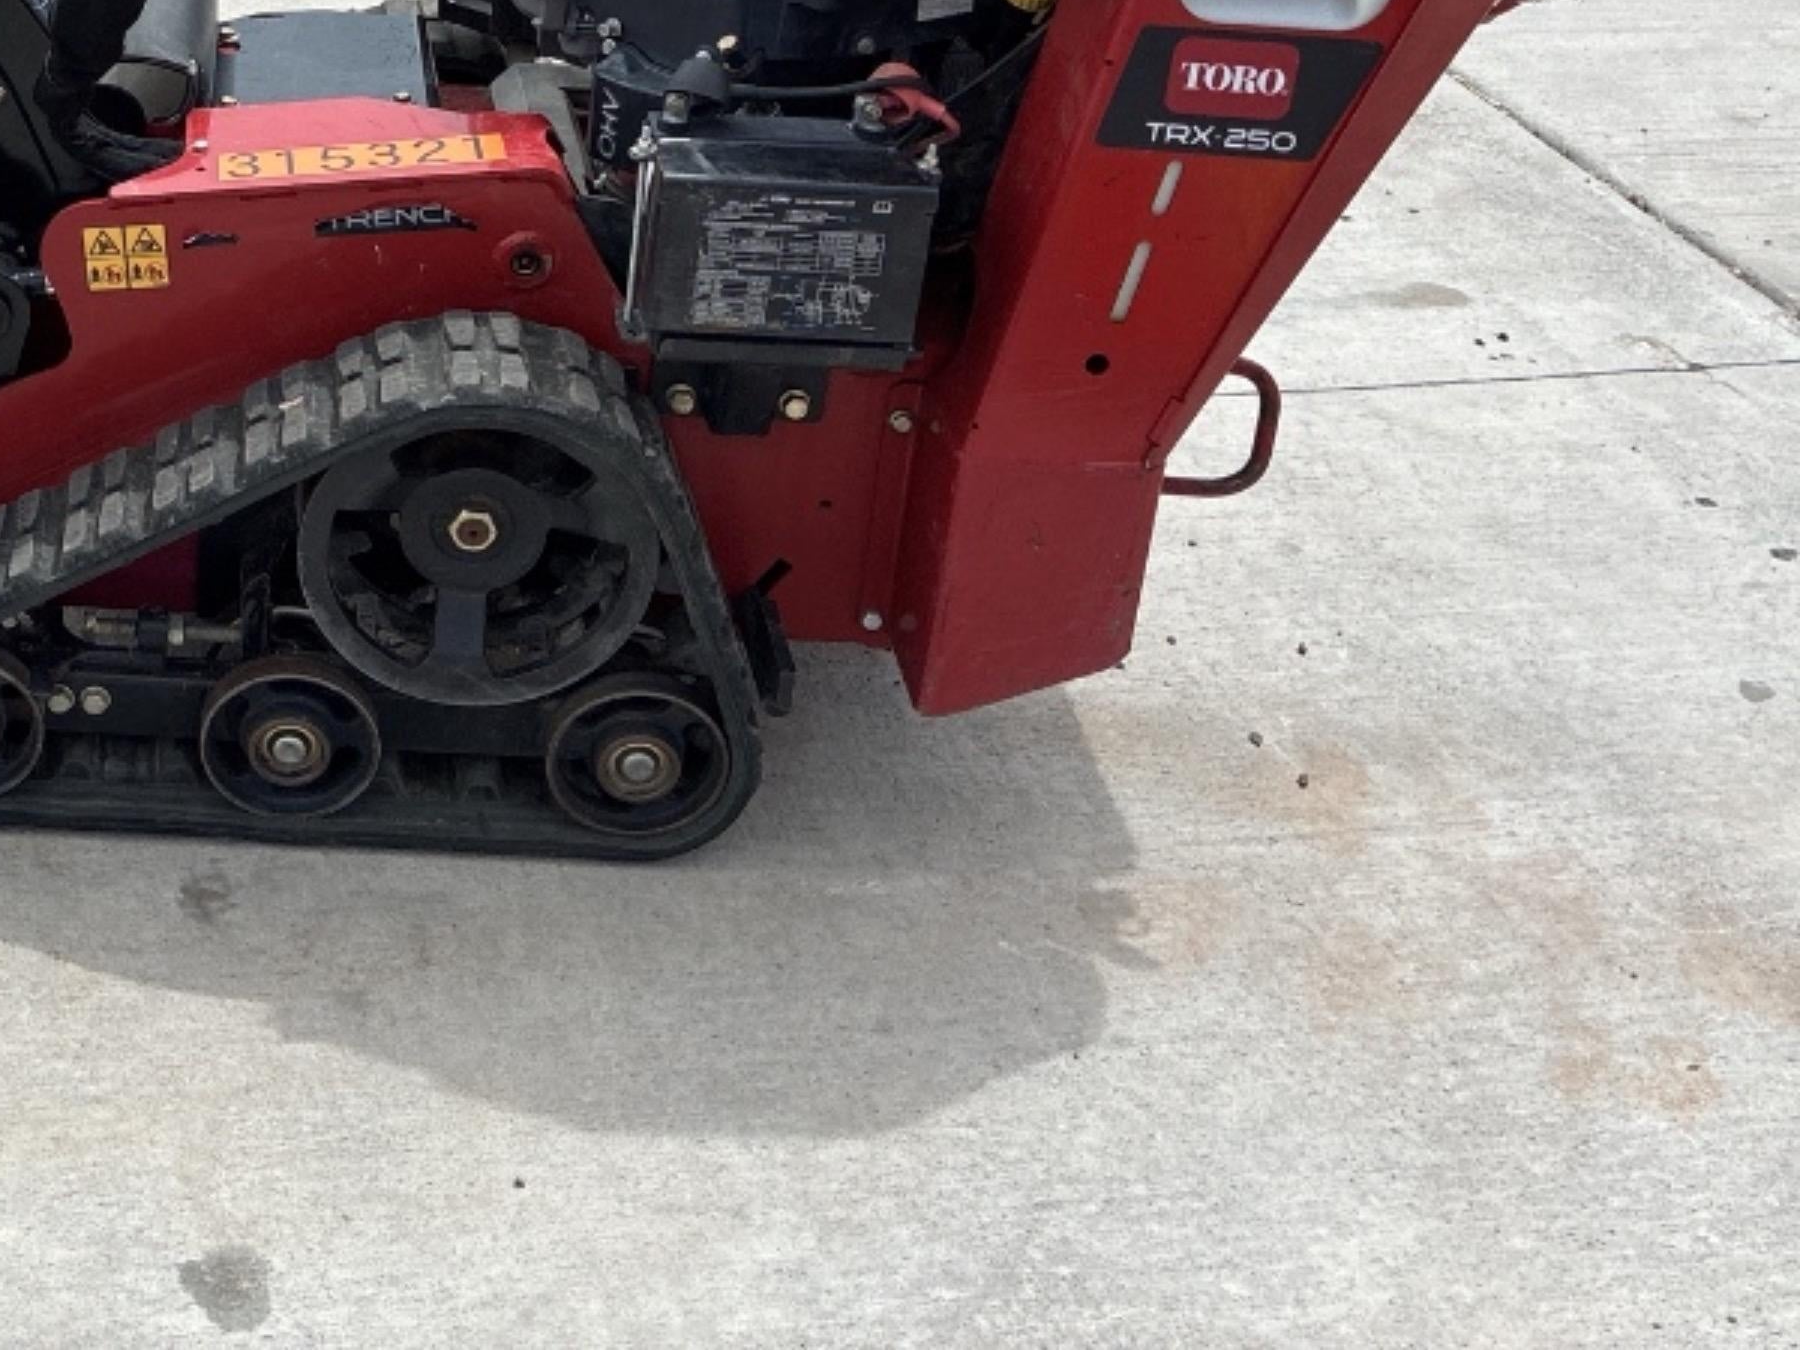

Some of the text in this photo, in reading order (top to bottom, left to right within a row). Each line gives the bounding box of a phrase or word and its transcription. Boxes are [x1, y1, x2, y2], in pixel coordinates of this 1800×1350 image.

[1182, 62, 1285, 95] TORO
[1145, 121, 1297, 152] TRX-250
[227, 134, 485, 178] 315321
